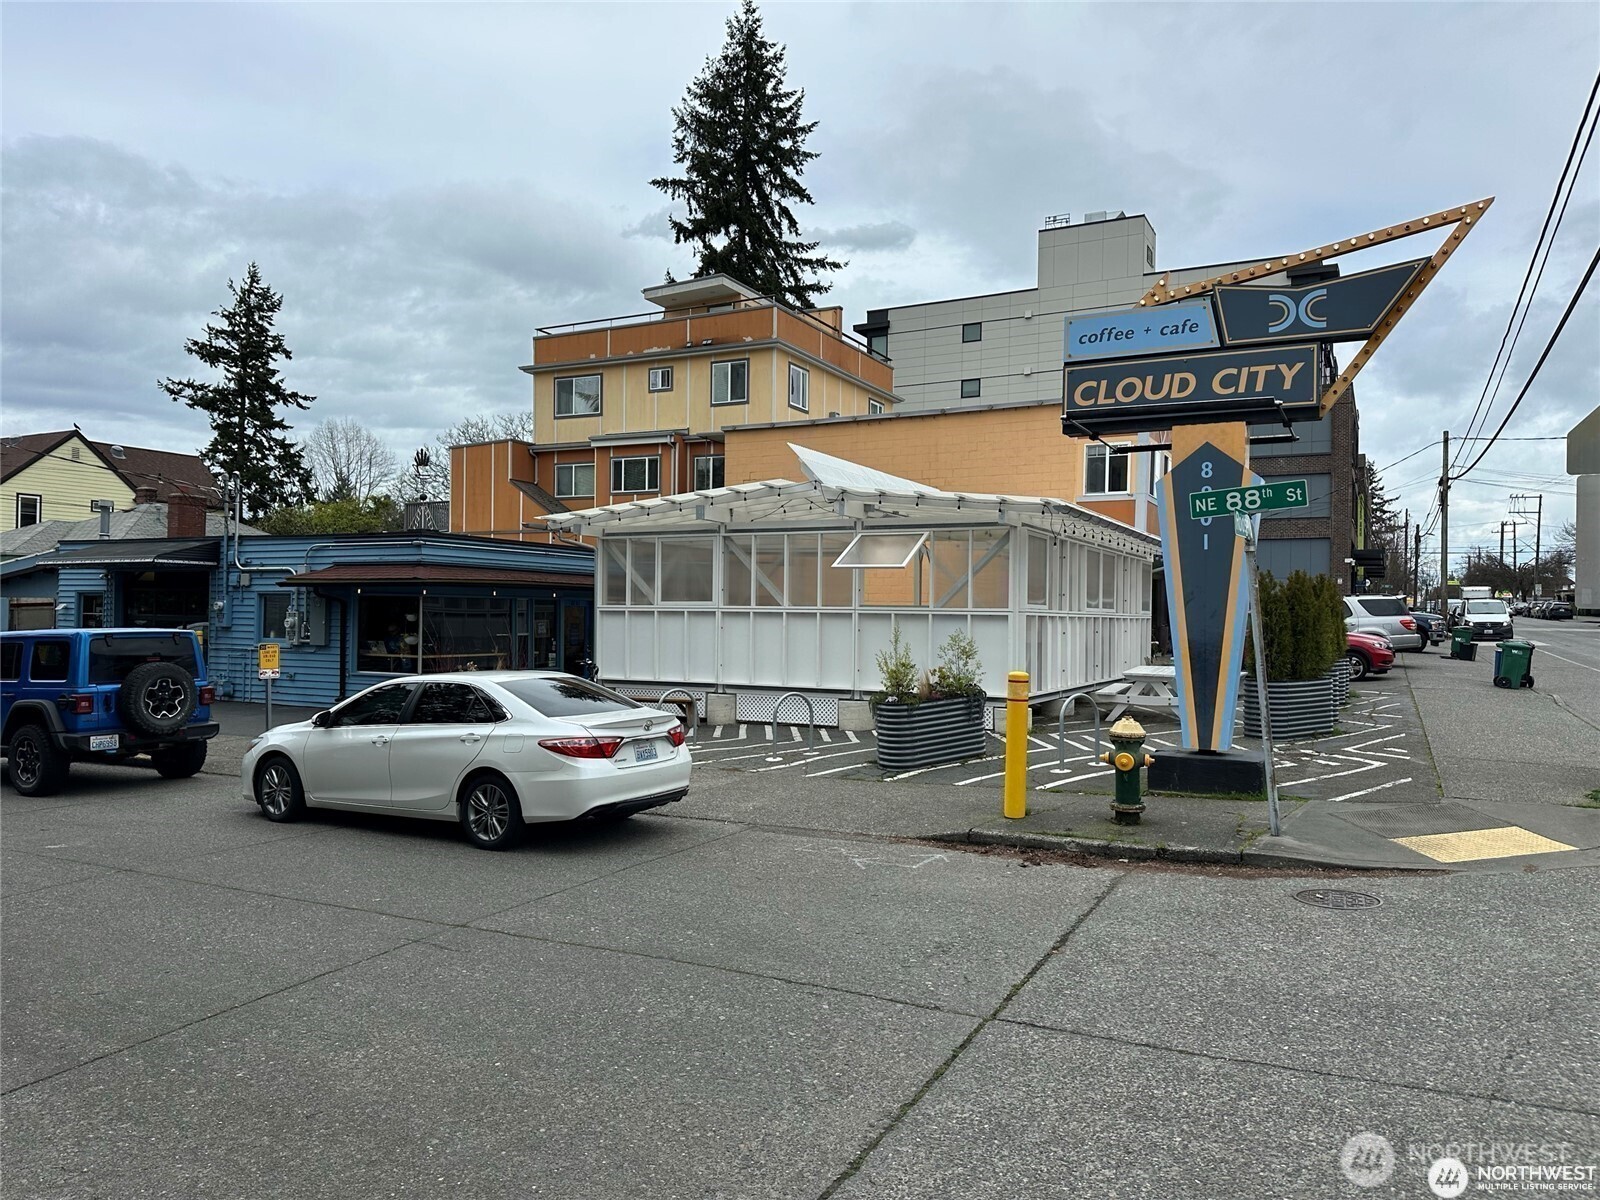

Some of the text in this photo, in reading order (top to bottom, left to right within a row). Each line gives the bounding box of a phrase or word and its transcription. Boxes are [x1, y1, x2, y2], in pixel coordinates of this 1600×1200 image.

[1078, 327, 1135, 345] coffee
[1159, 318, 1199, 336] cafe
[1073, 361, 1306, 407] CLOUD CITY
[1195, 487, 1303, 512] NE 88th St
